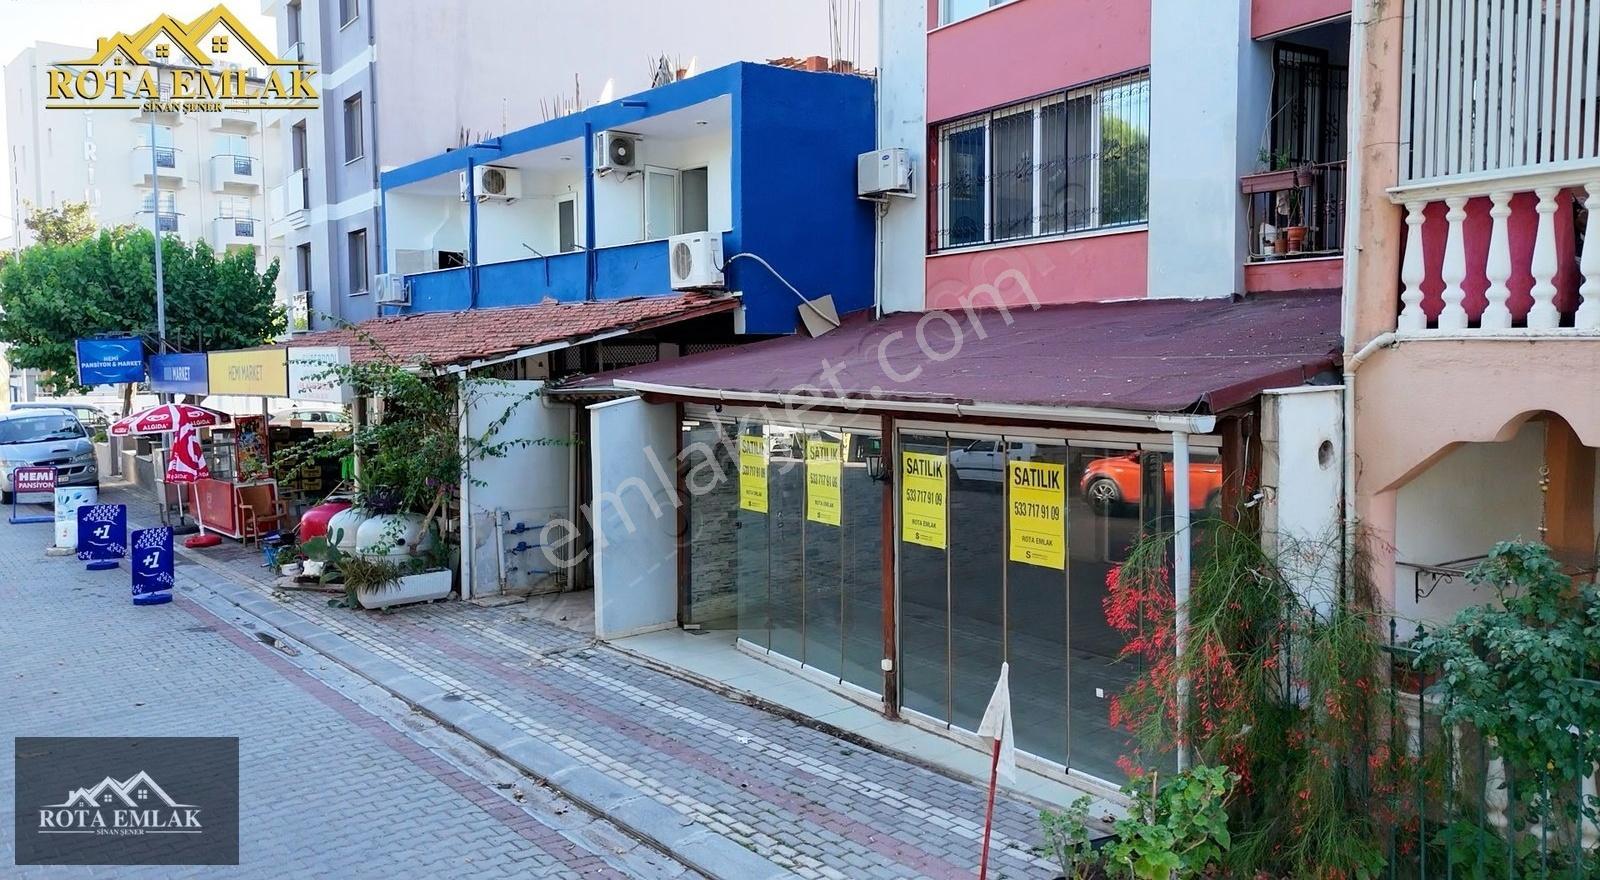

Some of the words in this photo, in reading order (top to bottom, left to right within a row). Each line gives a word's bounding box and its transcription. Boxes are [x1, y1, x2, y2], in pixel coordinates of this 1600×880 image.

[172, 366, 191, 381] MARKET
[142, 423, 167, 431] ALGIDA
[810, 445, 838, 460] SATILIK
[906, 457, 943, 478] SATILIK
[18, 470, 54, 481] HEMİ
[1014, 466, 1060, 490] SATILIK
[18, 481, 54, 489] PANSİYON
[906, 488, 917, 501] 533
[917, 490, 927, 503] 717
[927, 491, 934, 505] 91
[935, 492, 942, 506] 09
[1014, 501, 1027, 516] 533
[1028, 503, 1040, 518] 717
[1041, 504, 1049, 520] 91
[1051, 505, 1060, 521] 09
[93, 524, 111, 539] +1
[912, 519, 922, 527] ROTA
[923, 520, 936, 529] EMLAK
[1022, 535, 1035, 544] ROTA
[1035, 537, 1053, 547] EMLAK
[142, 551, 160, 569] +1
